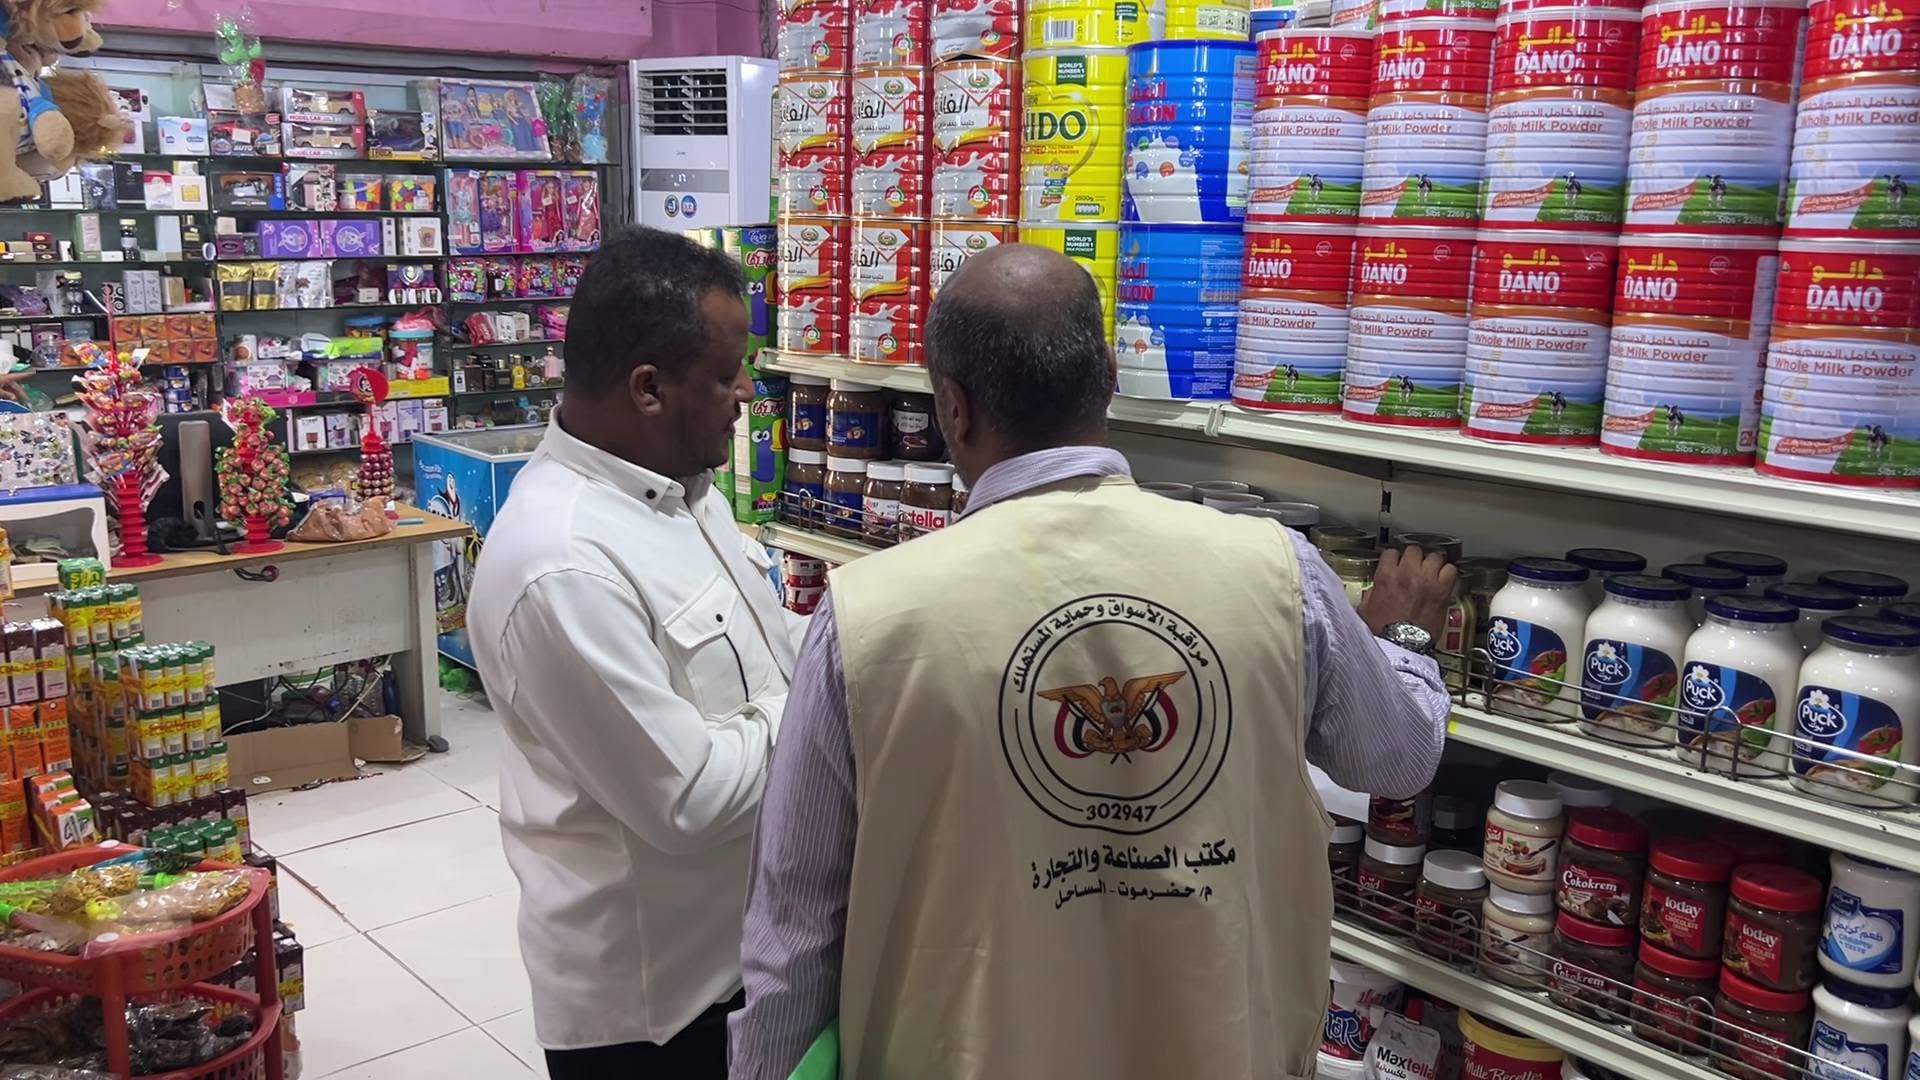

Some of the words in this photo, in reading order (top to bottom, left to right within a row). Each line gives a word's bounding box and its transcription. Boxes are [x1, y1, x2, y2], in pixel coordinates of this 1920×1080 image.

[1656, 40, 1721, 69] DANO
[1829, 28, 1903, 60] DANO
[1378, 57, 1425, 81] DANO
[1515, 49, 1576, 75] DANO
[1267, 63, 1316, 85] DANO
[1381, 123, 1401, 134] Milk
[1405, 123, 1452, 133] Powder
[1521, 121, 1546, 131] Milk
[1551, 120, 1603, 131] Powder
[1662, 118, 1688, 128] Milk
[1694, 117, 1752, 128] Powder
[1834, 111, 1864, 125] Milk
[1870, 111, 1920, 124] Powd
[1272, 126, 1293, 136] Milk
[1296, 125, 1342, 136] Powder
[1248, 257, 1293, 279] DANO
[1360, 263, 1407, 284] DANO
[1499, 270, 1561, 294] DANO
[1624, 275, 1678, 302] DANO
[1806, 284, 1883, 313] DANO
[1252, 316, 1270, 326] Milk
[1273, 317, 1317, 329] Powder
[1364, 325, 1384, 336] Milk
[1387, 326, 1434, 338] Powder
[1506, 337, 1532, 348] Milk
[1536, 338, 1587, 351] Powder
[1626, 345, 1649, 358] Milk
[1653, 348, 1709, 362] Powder
[1775, 357, 1809, 372] Whole
[1814, 362, 1846, 376] Milk
[1851, 364, 1915, 378] Powder
[1054, 604, 1105, 630] وحماية
[1108, 599, 1164, 626] الأسواق
[1166, 619, 1209, 668] مراقبة
[1489, 634, 1515, 652] Puck
[1013, 625, 1053, 694] المستهلك
[1591, 658, 1624, 676] Puck
[1686, 681, 1718, 702] Puck
[1801, 705, 1838, 728] Puck
[1086, 803, 1158, 821] 302947
[1103, 844, 1178, 869] الصناعة
[1184, 839, 1236, 874] مكتب
[1032, 848, 1100, 889] والتجارة
[1056, 879, 1106, 909] الساحل
[1118, 881, 1195, 900] حضرموت
[1665, 896, 1701, 919] today
[1665, 915, 1699, 930] CHOCOLATE
[1743, 924, 1779, 948] today
[1742, 942, 1777, 960] CHOCOLATE
[1376, 1046, 1437, 1080] Maxtella
[1465, 1060, 1489, 1080] Mille
